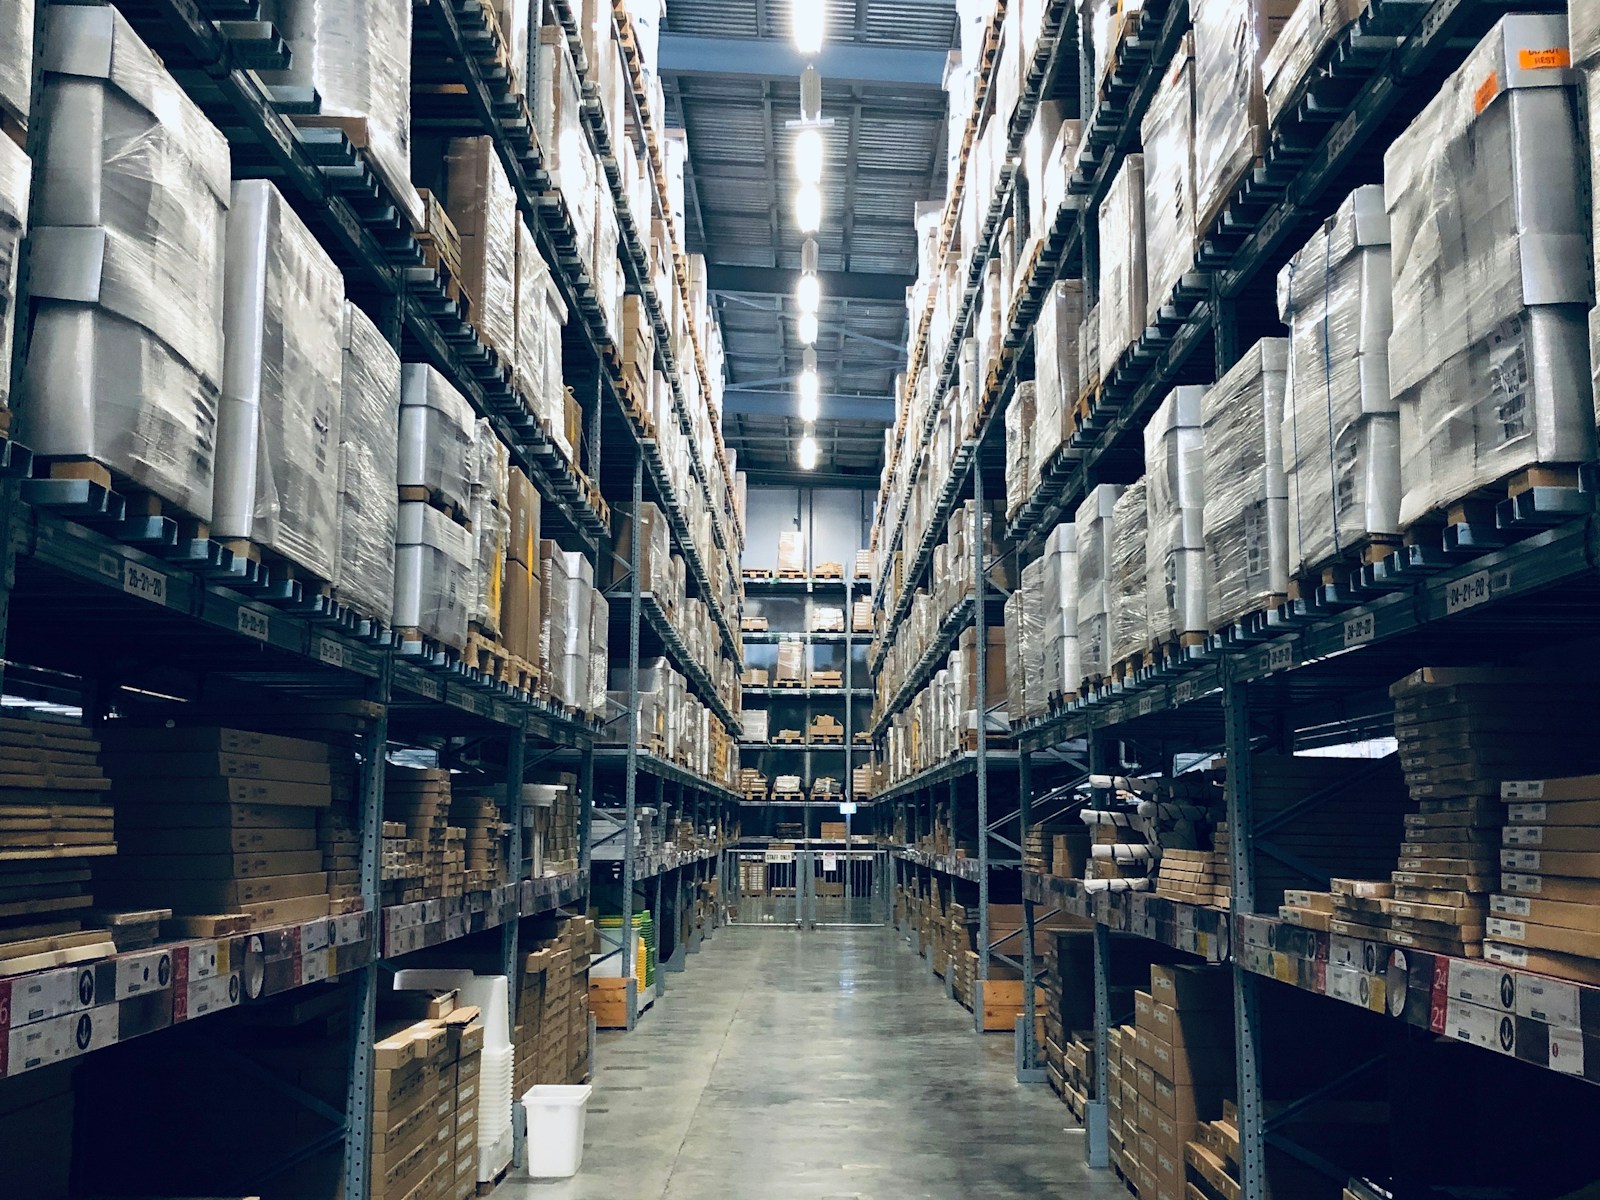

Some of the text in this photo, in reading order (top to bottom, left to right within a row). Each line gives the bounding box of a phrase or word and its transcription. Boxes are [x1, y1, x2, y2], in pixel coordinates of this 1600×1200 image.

[1534, 56, 1555, 65] REST
[128, 567, 162, 597] 26-21-20
[1450, 577, 1485, 607] 24-21-20
[1433, 968, 1447, 990] 24
[1431, 1006, 1444, 1029] 21
